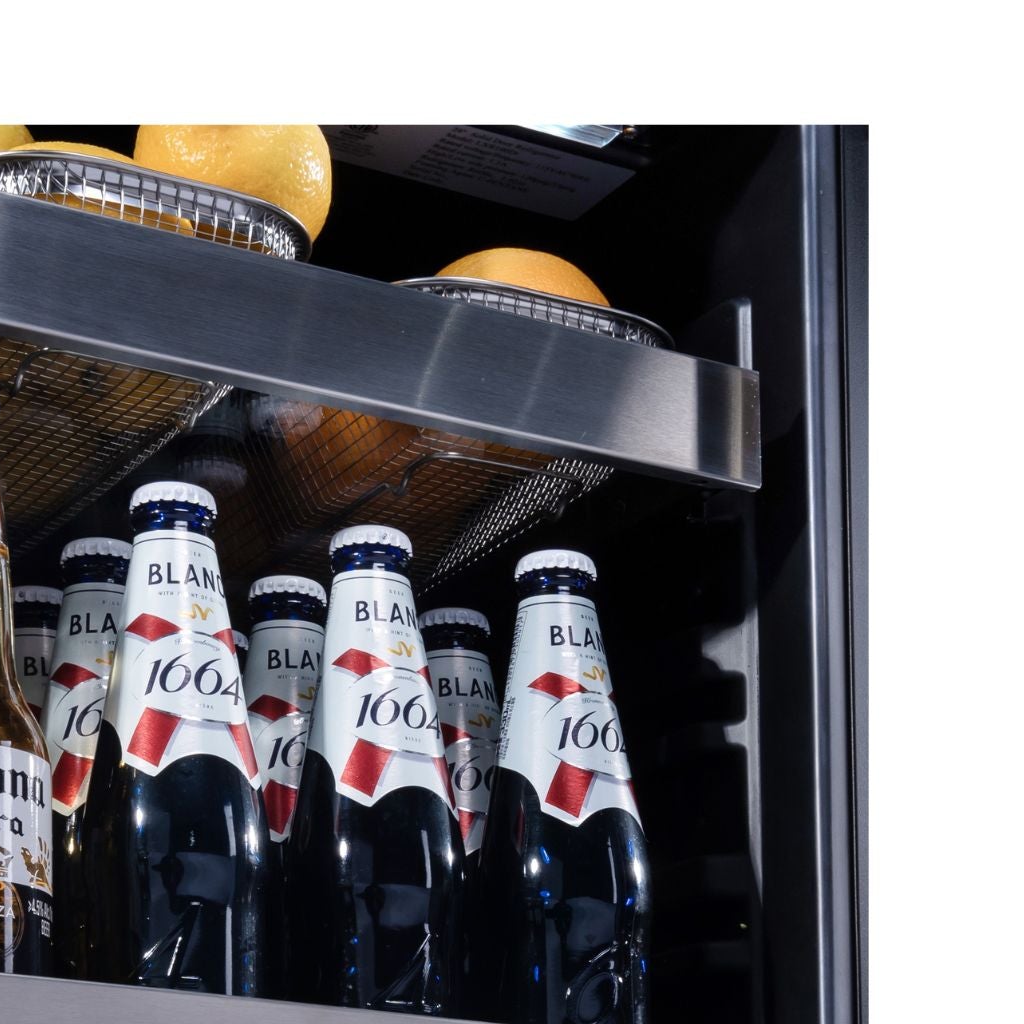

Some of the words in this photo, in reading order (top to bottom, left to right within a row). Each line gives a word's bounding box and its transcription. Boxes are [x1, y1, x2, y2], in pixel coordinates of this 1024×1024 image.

[69, 612, 118, 636] BLA
[355, 600, 419, 631] BLAN
[550, 625, 605, 655] BLAN
[144, 652, 243, 706] 1664
[438, 677, 496, 703] BLAN
[62, 696, 105, 741] 16
[356, 687, 441, 740] 1664
[267, 731, 307, 770] 16
